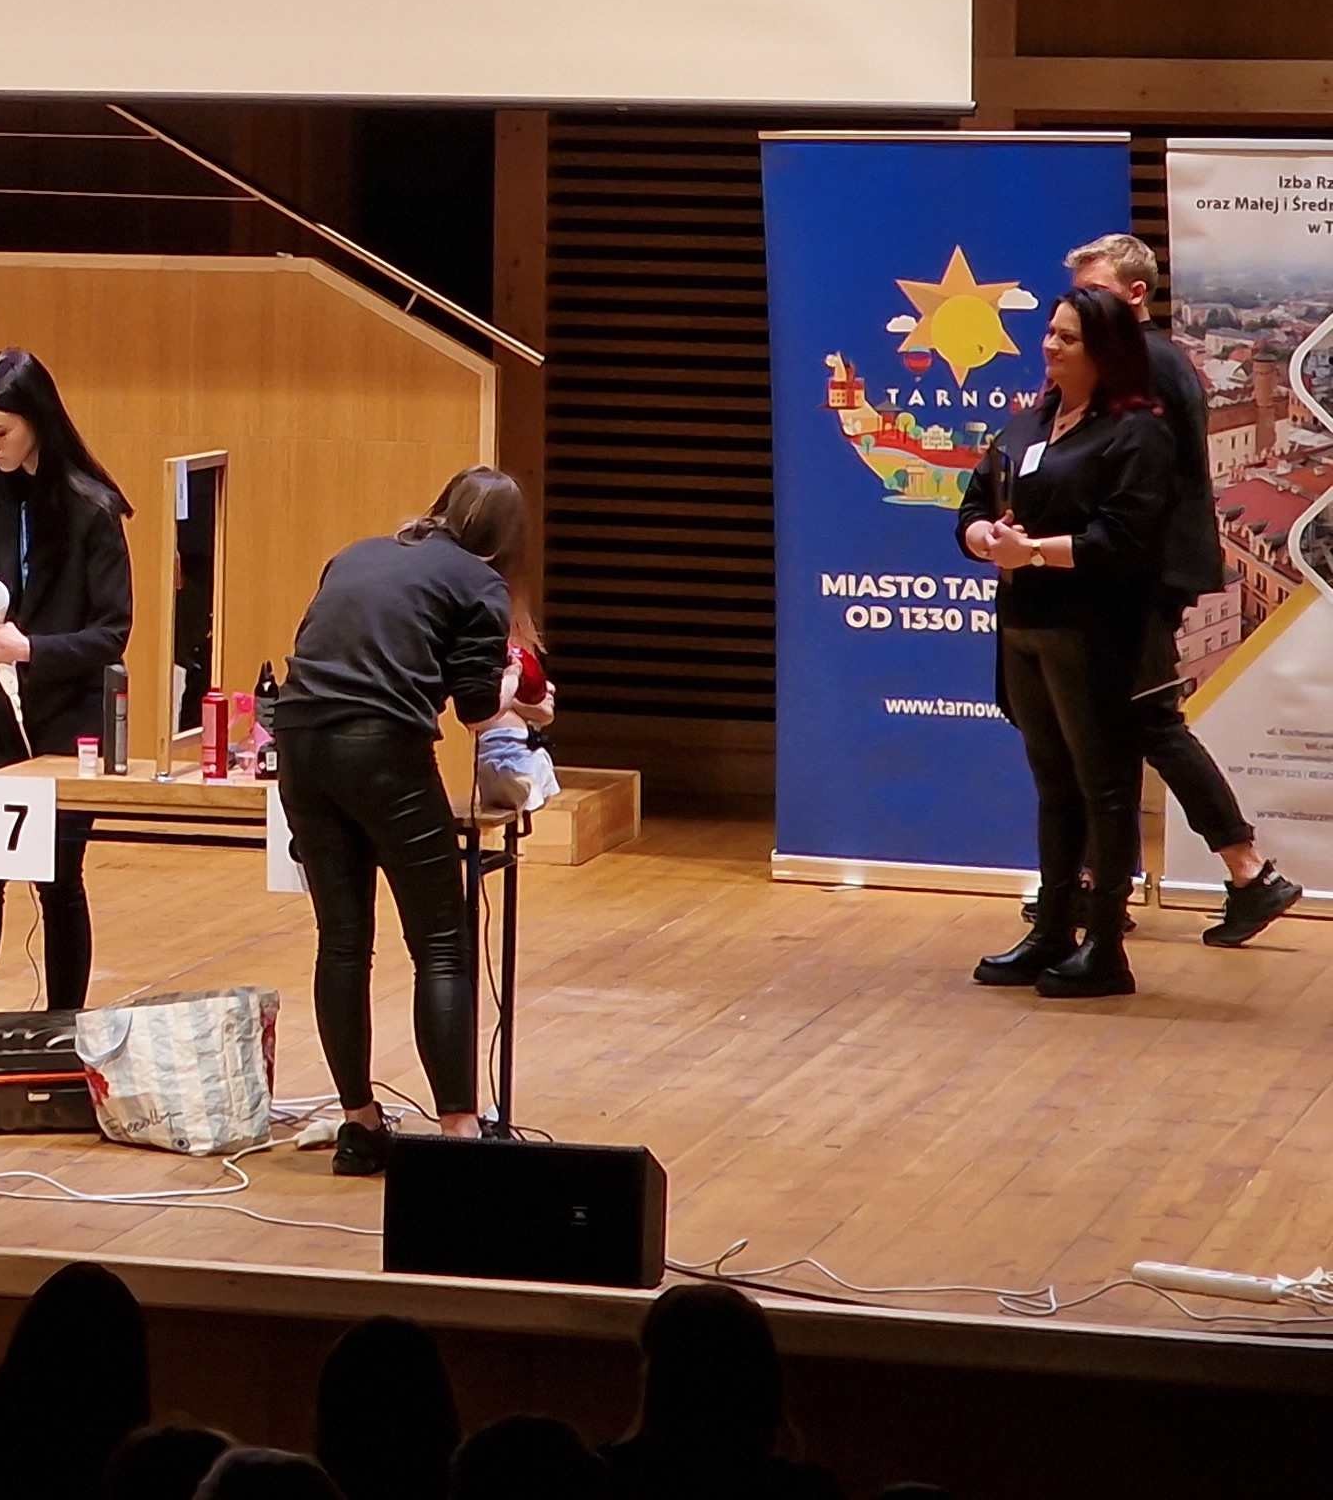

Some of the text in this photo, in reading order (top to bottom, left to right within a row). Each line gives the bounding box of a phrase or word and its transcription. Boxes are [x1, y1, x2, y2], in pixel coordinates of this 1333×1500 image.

[1278, 175, 1311, 189] Izba
[1196, 199, 1230, 209] oraz
[1235, 197, 1279, 214] Małej
[1307, 223, 1321, 234] w
[886, 386, 1038, 409] TARNÓW
[821, 573, 937, 599] MIASTO
[845, 605, 998, 633] OD 1330 R
[3, 804, 29, 851] 7
